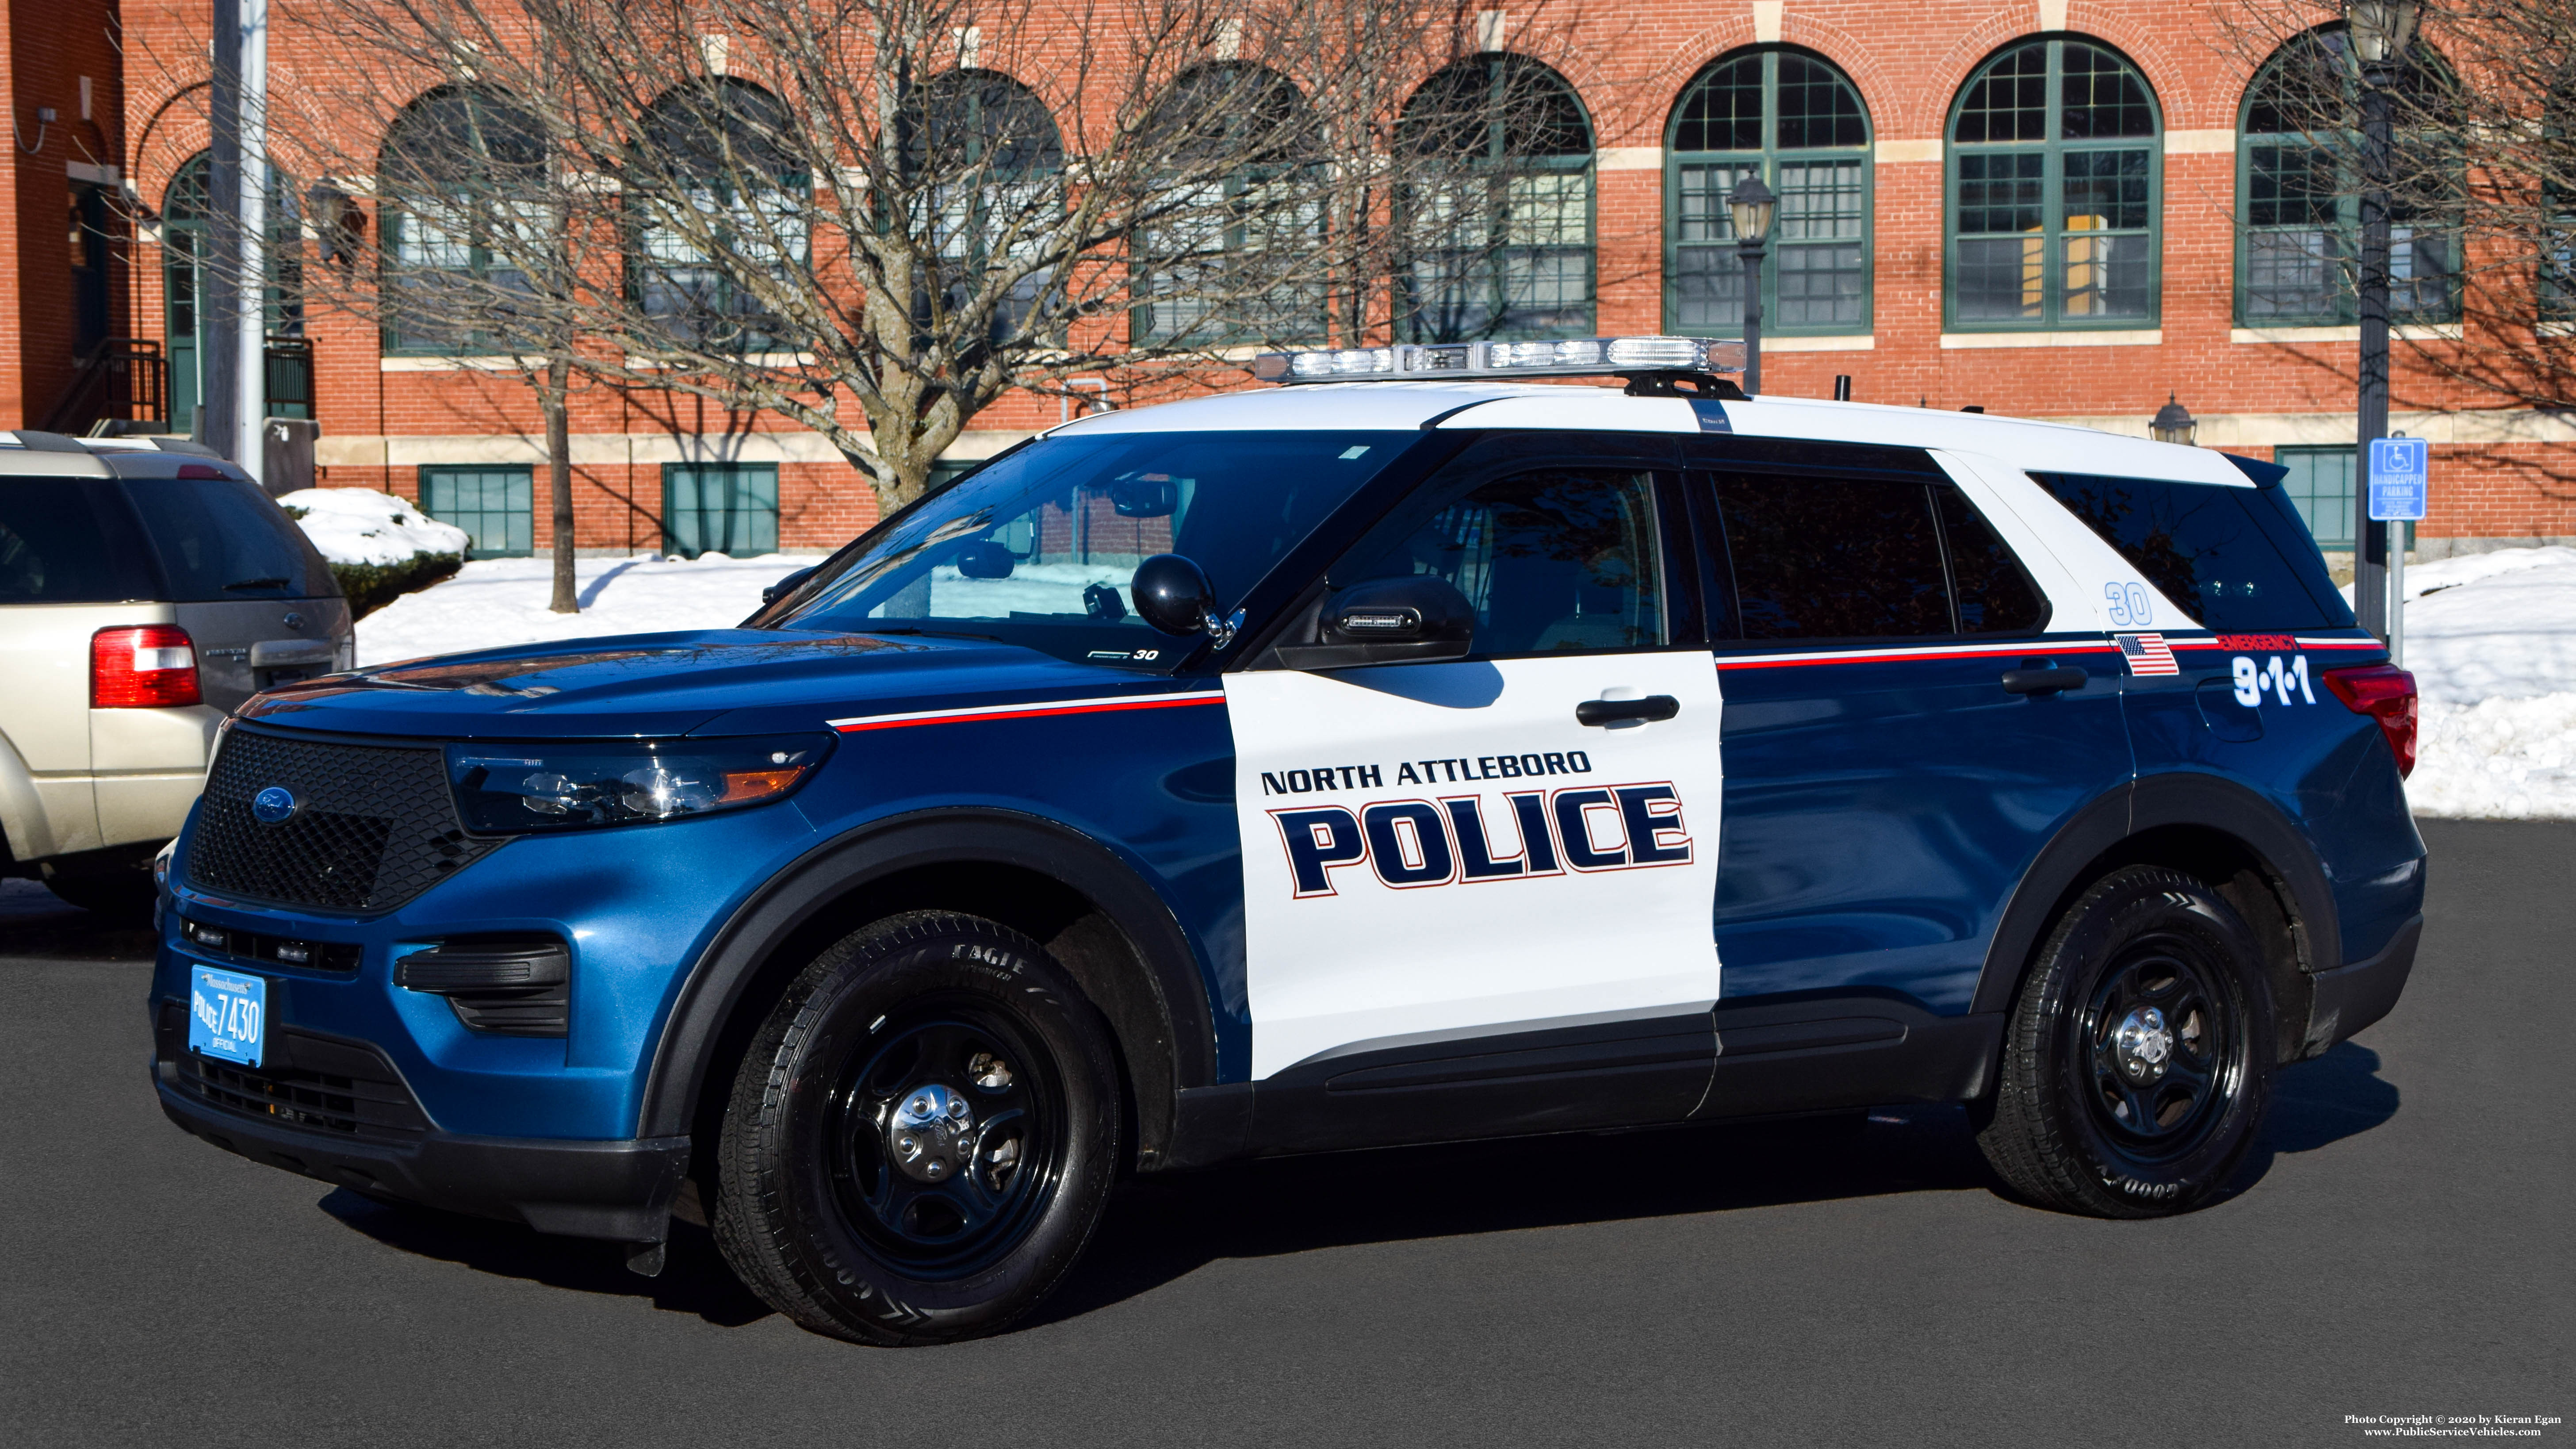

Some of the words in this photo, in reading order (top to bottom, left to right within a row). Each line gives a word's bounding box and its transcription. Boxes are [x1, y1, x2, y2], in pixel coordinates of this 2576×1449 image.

[2373, 474, 2423, 485] HANDICAPPED
[2382, 486, 2413, 496] PARKING
[2105, 582, 2152, 626] 30
[2215, 634, 2298, 651] EMERGENCY
[1133, 649, 1159, 660] 30
[1260, 764, 1382, 796] NORTH
[1397, 751, 1592, 786] ATTLEBORO
[1265, 780, 1694, 900] POLICE
[206, 974, 248, 995] Massachusetts
[193, 990, 217, 1034] POLICE
[218, 994, 259, 1044] 7430
[212, 1037, 237, 1053] OFFICIAL
